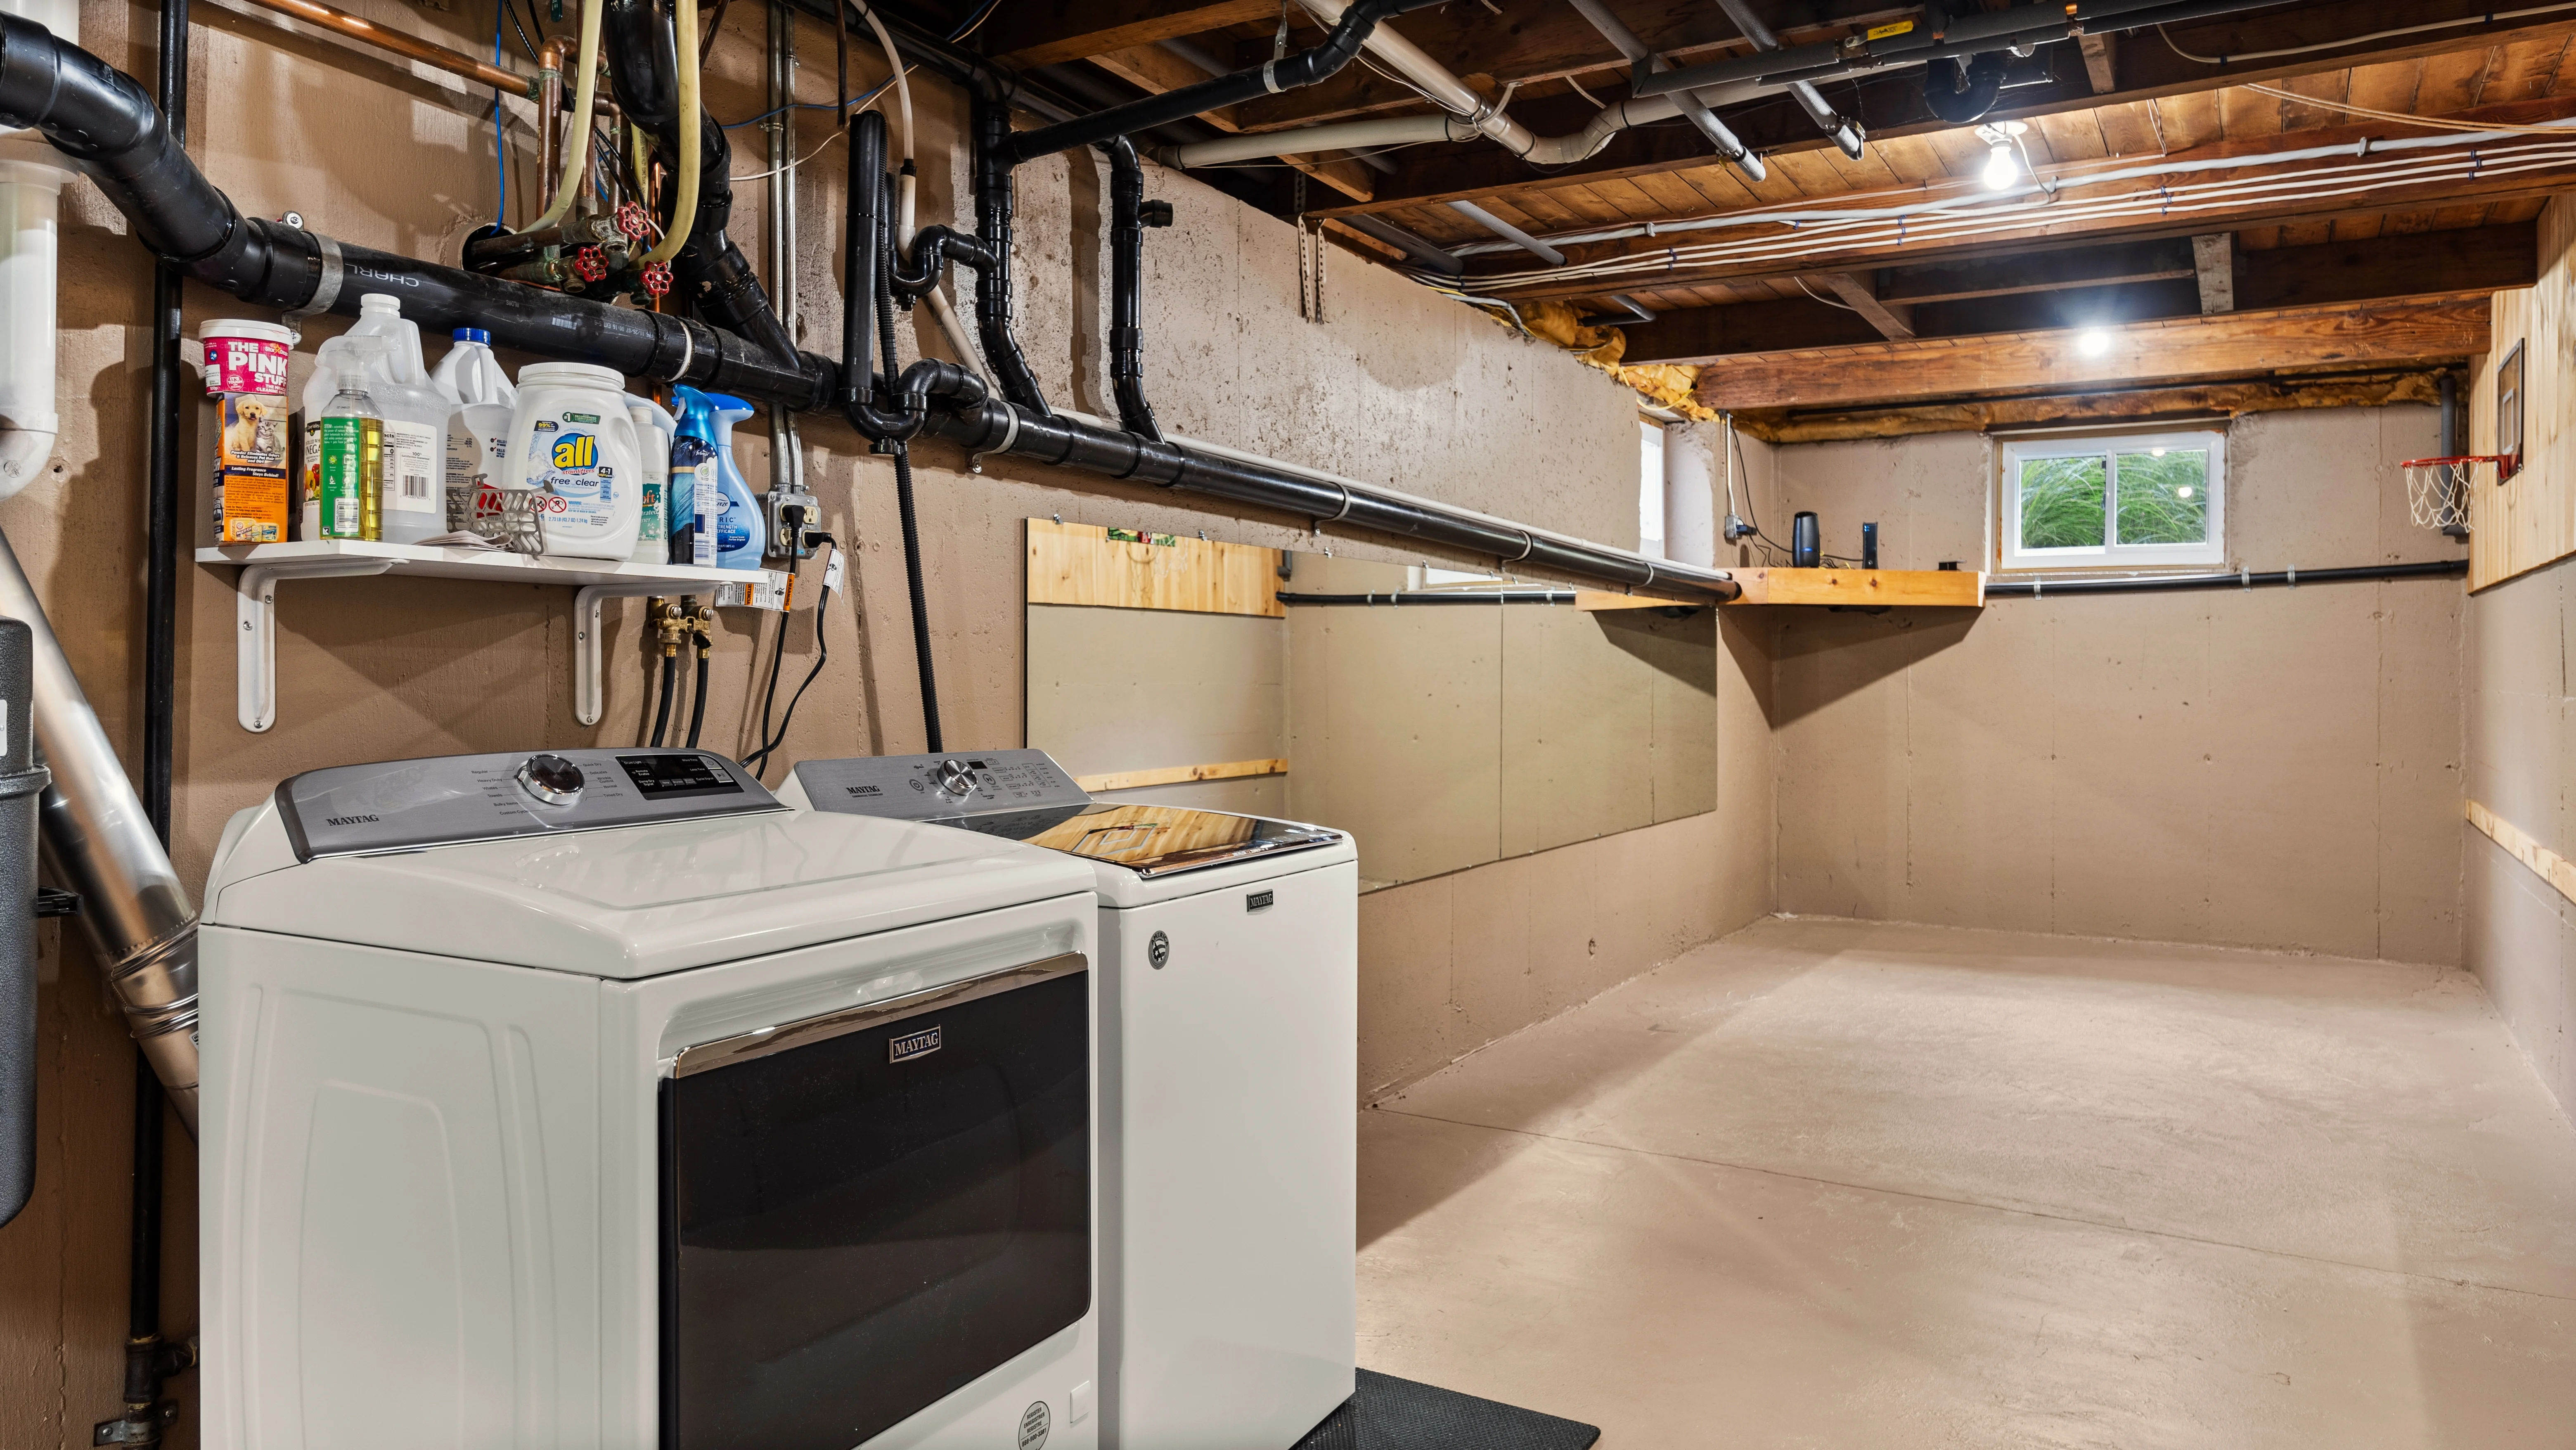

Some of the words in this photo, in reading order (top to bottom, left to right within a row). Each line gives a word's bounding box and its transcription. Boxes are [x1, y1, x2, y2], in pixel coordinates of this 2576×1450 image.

[626, 327, 644, 336] 11/26/07
[228, 341, 259, 353] THE
[228, 352, 288, 377] PINK
[254, 373, 287, 386] STUFF
[564, 413, 571, 422] #1
[554, 436, 595, 468] all
[846, 786, 881, 794] MAYTAG
[326, 815, 379, 826] MAYTAG
[1250, 894, 1272, 907] MAYTAG
[1151, 932, 1169, 947] AMERICA
[895, 1033, 938, 1056] MAYTAG
[1027, 1407, 1042, 1420] REGISTER
[1024, 1412, 1045, 1429] ENREGISTRER
[1027, 1421, 1042, 1433] REGISTRE
